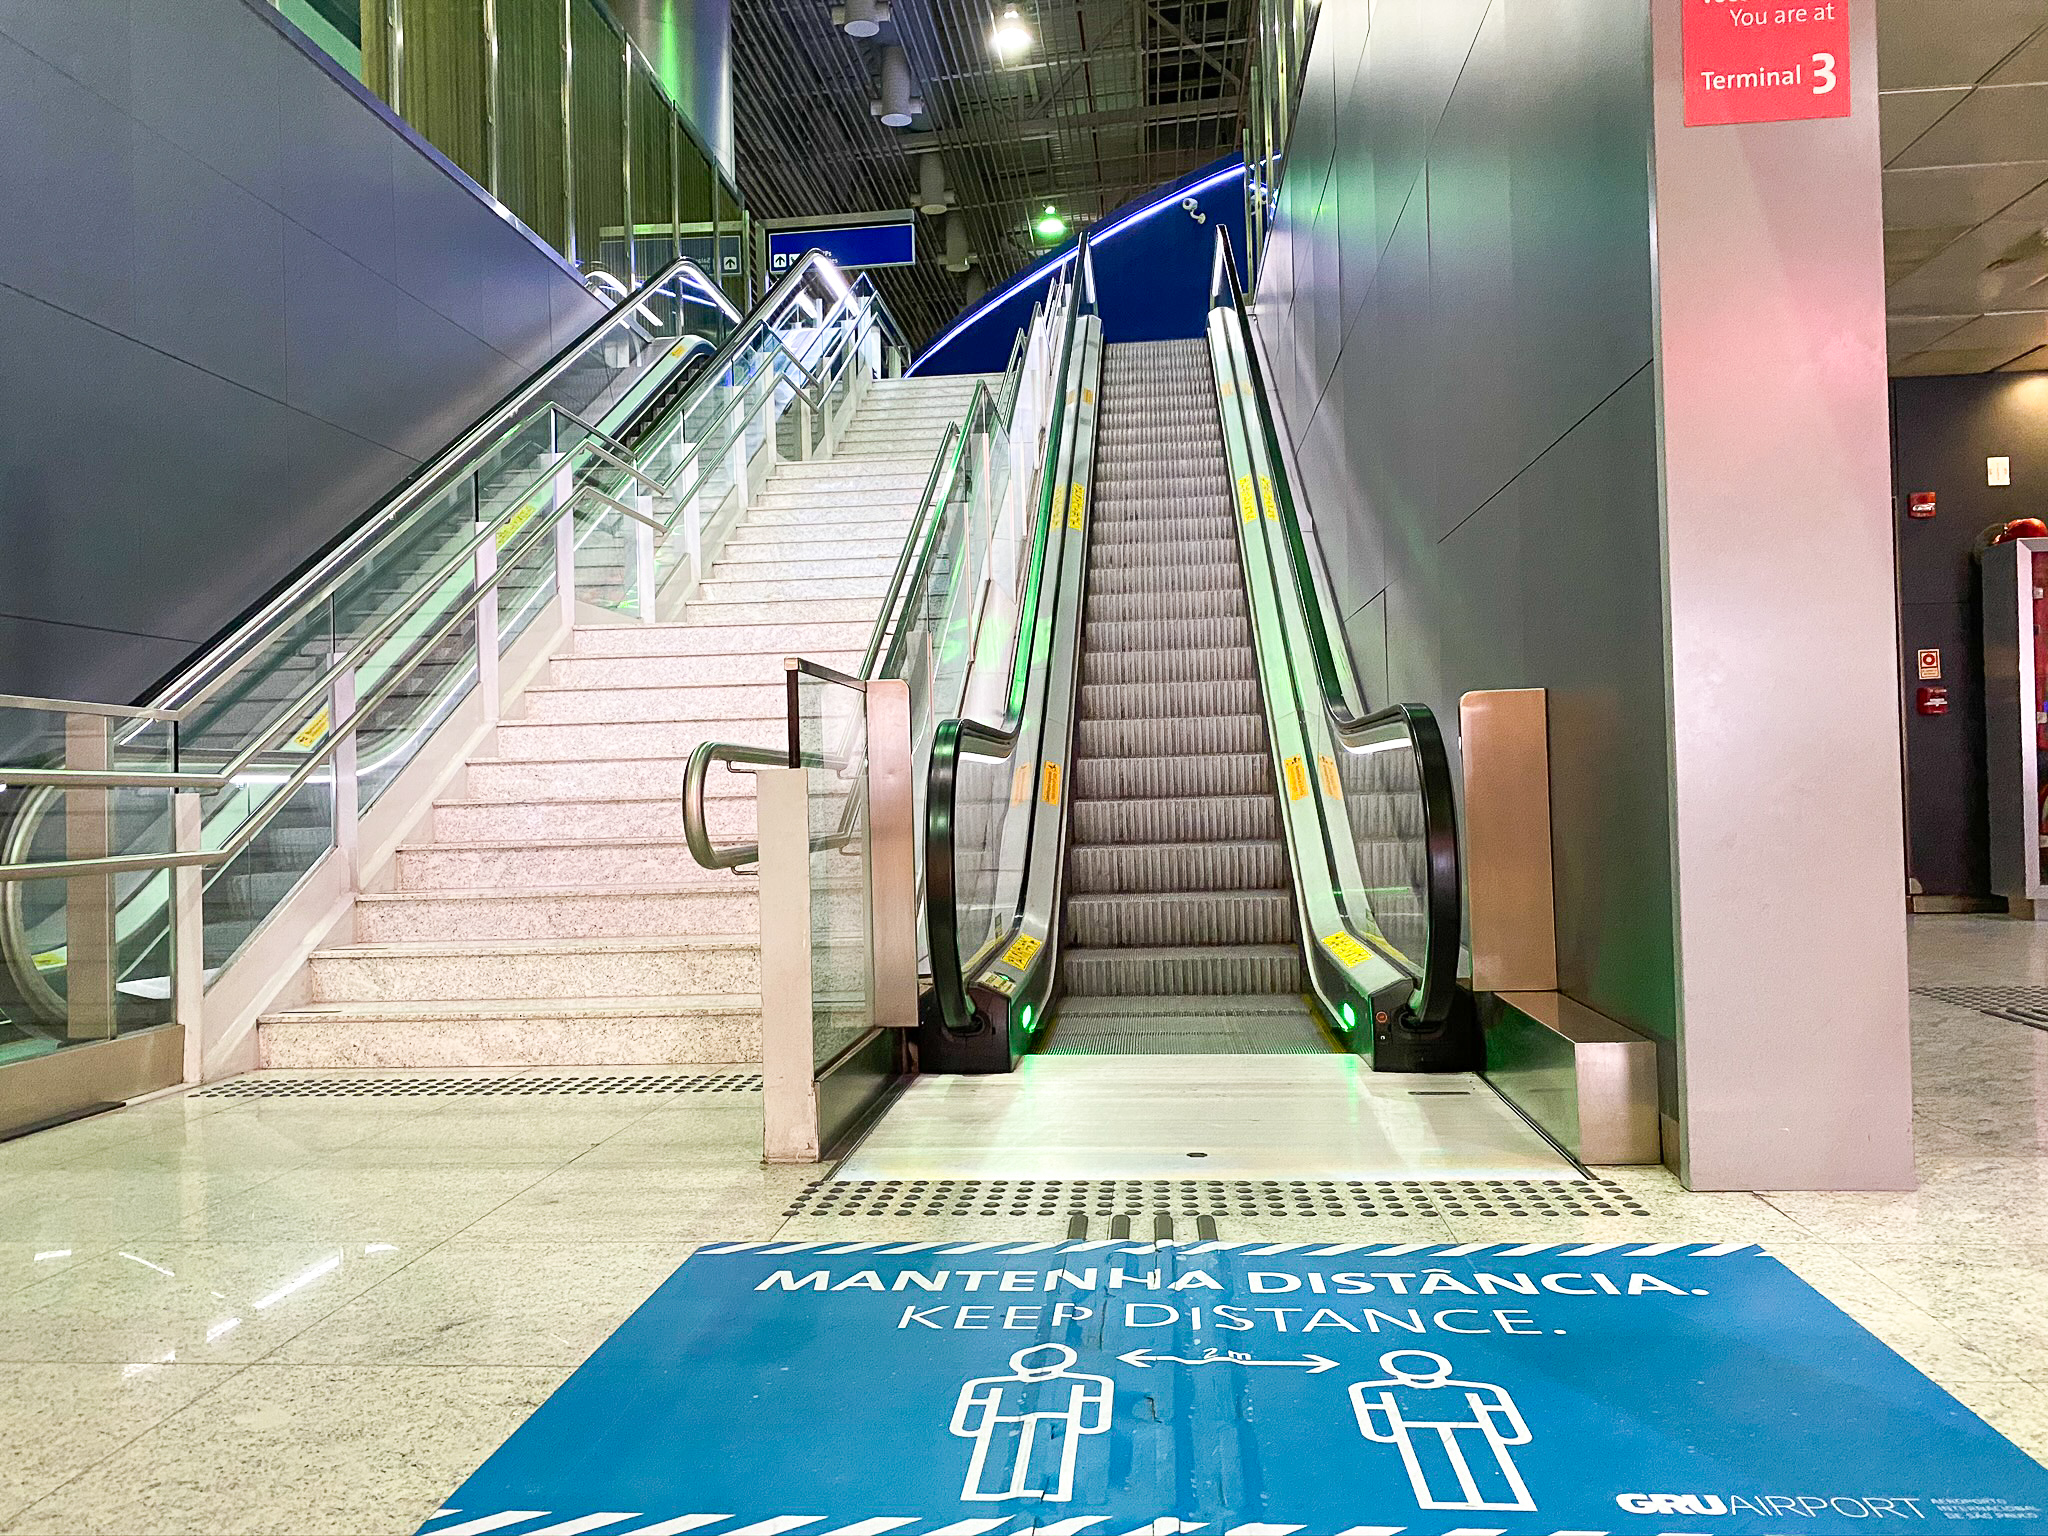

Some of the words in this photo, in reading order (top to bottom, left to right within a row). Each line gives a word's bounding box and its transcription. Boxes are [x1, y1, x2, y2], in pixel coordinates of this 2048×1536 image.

[1730, 9, 1767, 27] You
[1774, 8, 1807, 24] are
[1814, 3, 1835, 21] at
[1701, 64, 1801, 90] Terminal
[1812, 52, 1837, 94] 3
[754, 1267, 1225, 1292] MANTENHA
[1248, 1268, 1710, 1296] DISTÂNCIA.
[897, 1303, 1094, 1330] KEEP
[1124, 1303, 1567, 1335] DISTANCE.
